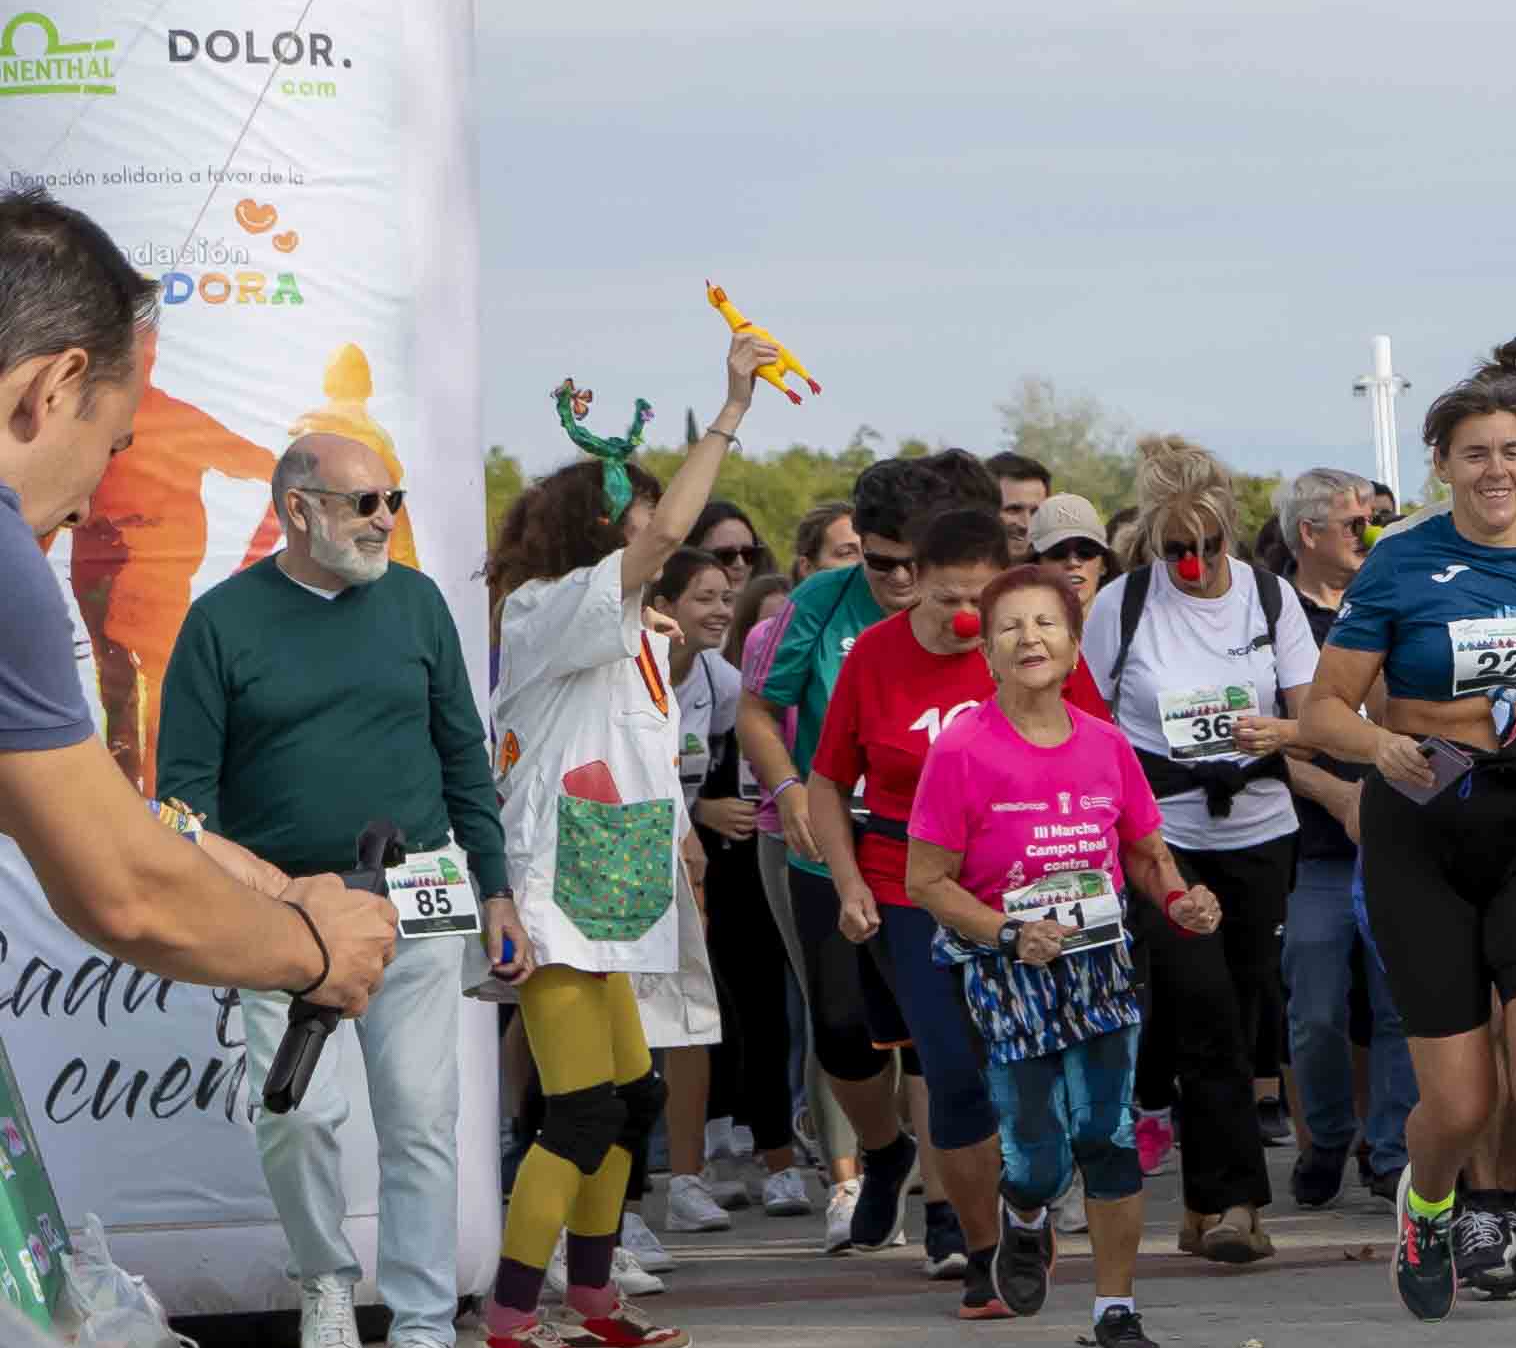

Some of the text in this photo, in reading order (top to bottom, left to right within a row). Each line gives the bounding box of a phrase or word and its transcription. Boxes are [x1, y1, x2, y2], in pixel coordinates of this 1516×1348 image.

[0, 57, 114, 81] NENTHAL
[281, 79, 338, 98] com
[102, 165, 183, 186] solidaria
[190, 172, 201, 183] a
[260, 167, 283, 184] de
[120, 236, 250, 266] ndación
[160, 271, 305, 305] DORA
[1191, 714, 1232, 742] 36
[1033, 822, 1100, 839] III Marcha
[1025, 837, 1107, 858] Campo Real
[1042, 858, 1089, 872] contra
[415, 888, 453, 917] 85
[0, 929, 174, 1026] ada
[45, 1055, 262, 1125] cuen
